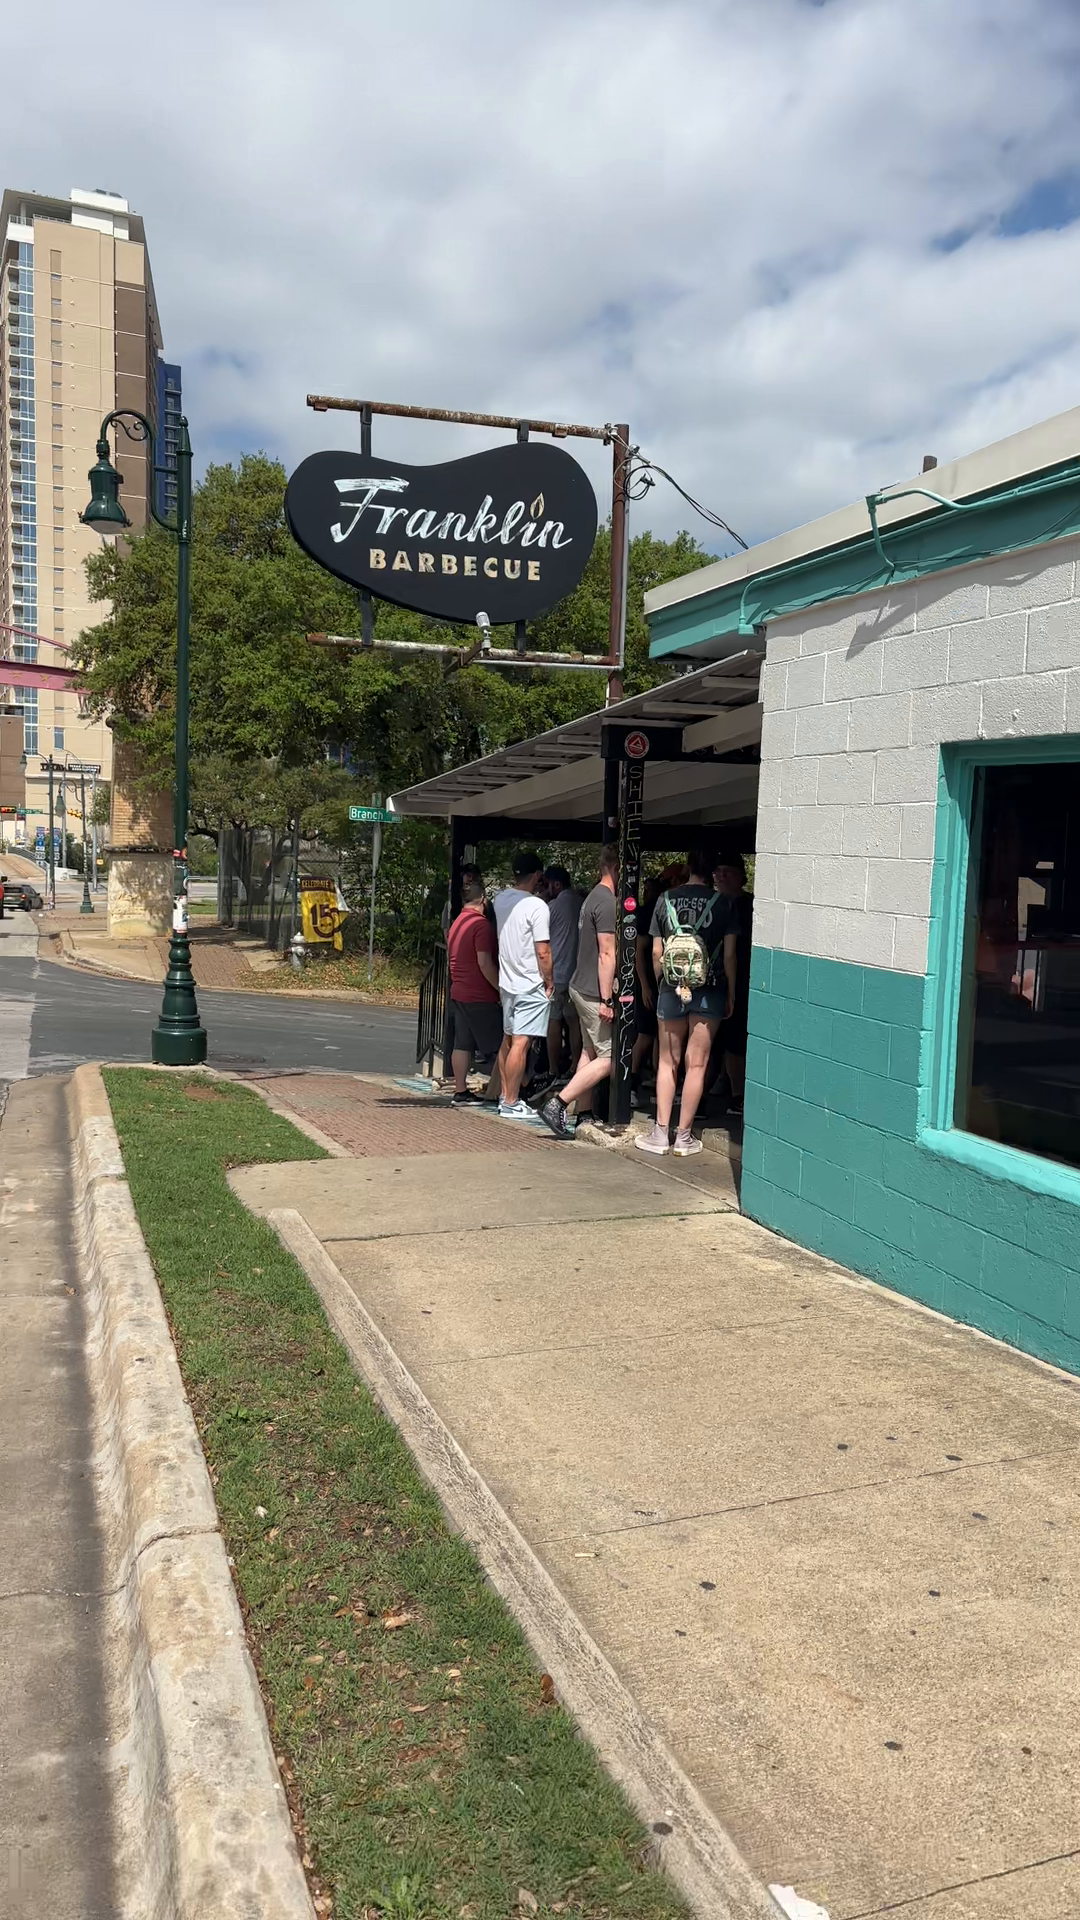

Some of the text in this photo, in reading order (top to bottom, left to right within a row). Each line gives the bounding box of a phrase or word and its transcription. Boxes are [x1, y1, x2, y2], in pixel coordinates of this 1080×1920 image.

[330, 476, 573, 549] Franklin
[369, 548, 541, 581] BARBECUE
[351, 807, 384, 820] Branch
[668, 896, 711, 913] UC-EE'
